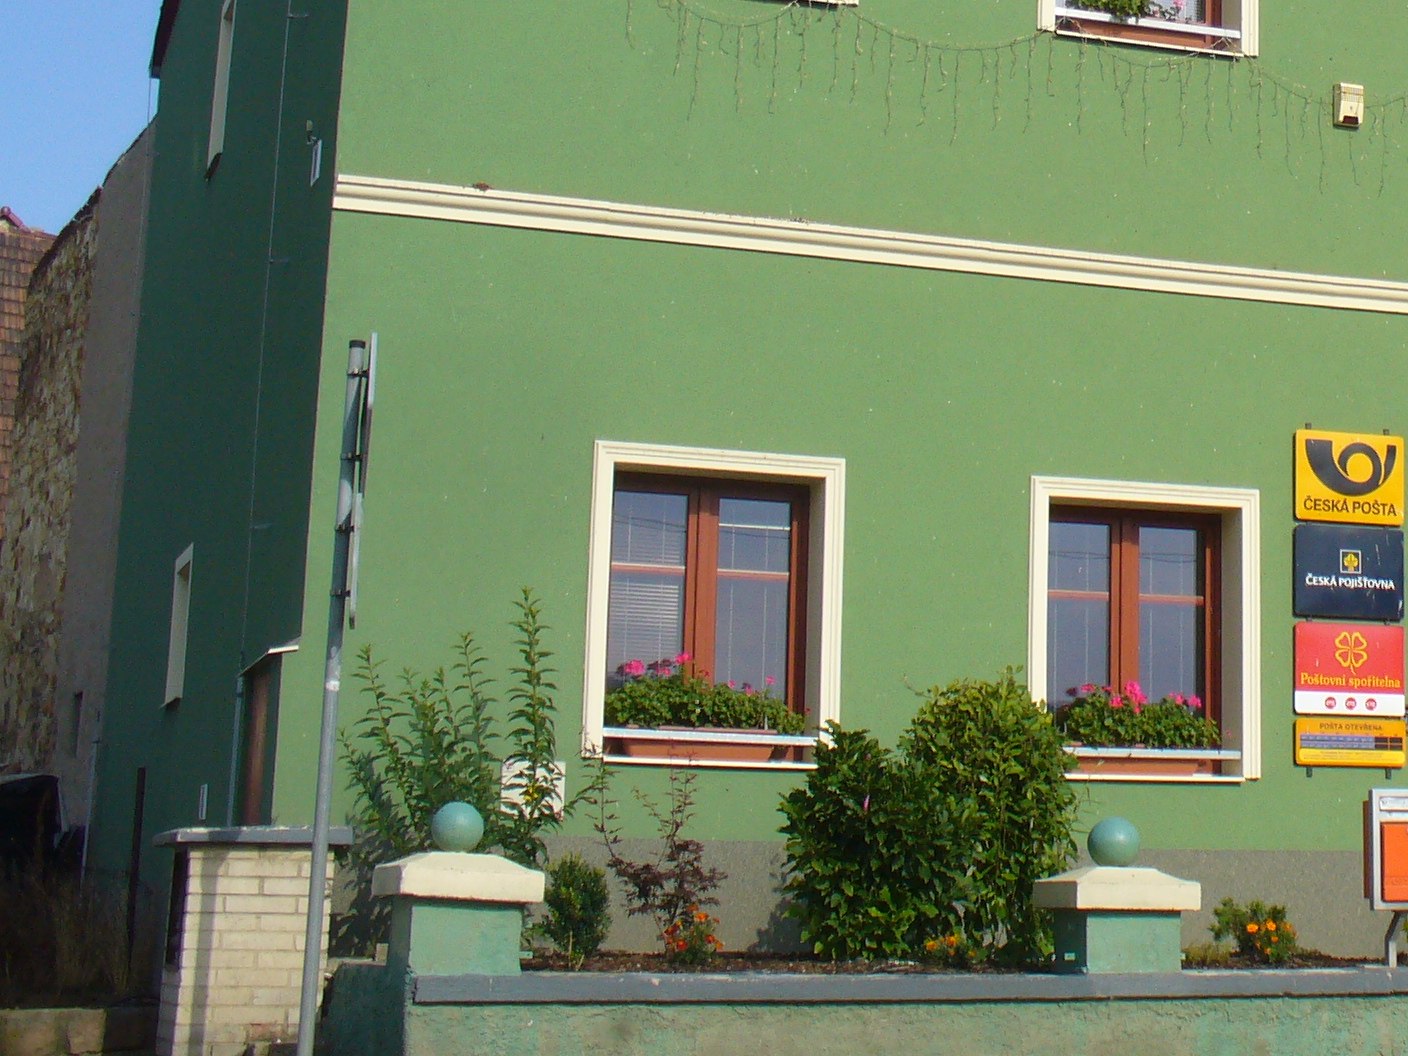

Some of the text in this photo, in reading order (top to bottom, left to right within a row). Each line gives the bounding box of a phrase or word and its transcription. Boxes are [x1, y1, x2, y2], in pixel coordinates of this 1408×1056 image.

[1304, 496, 1397, 517] ČESKÁ POŠTA
[1305, 573, 1395, 590] ČESKÁ POJIŠŤOVNA
[1300, 672, 1401, 689] Poštovní spořitelna
